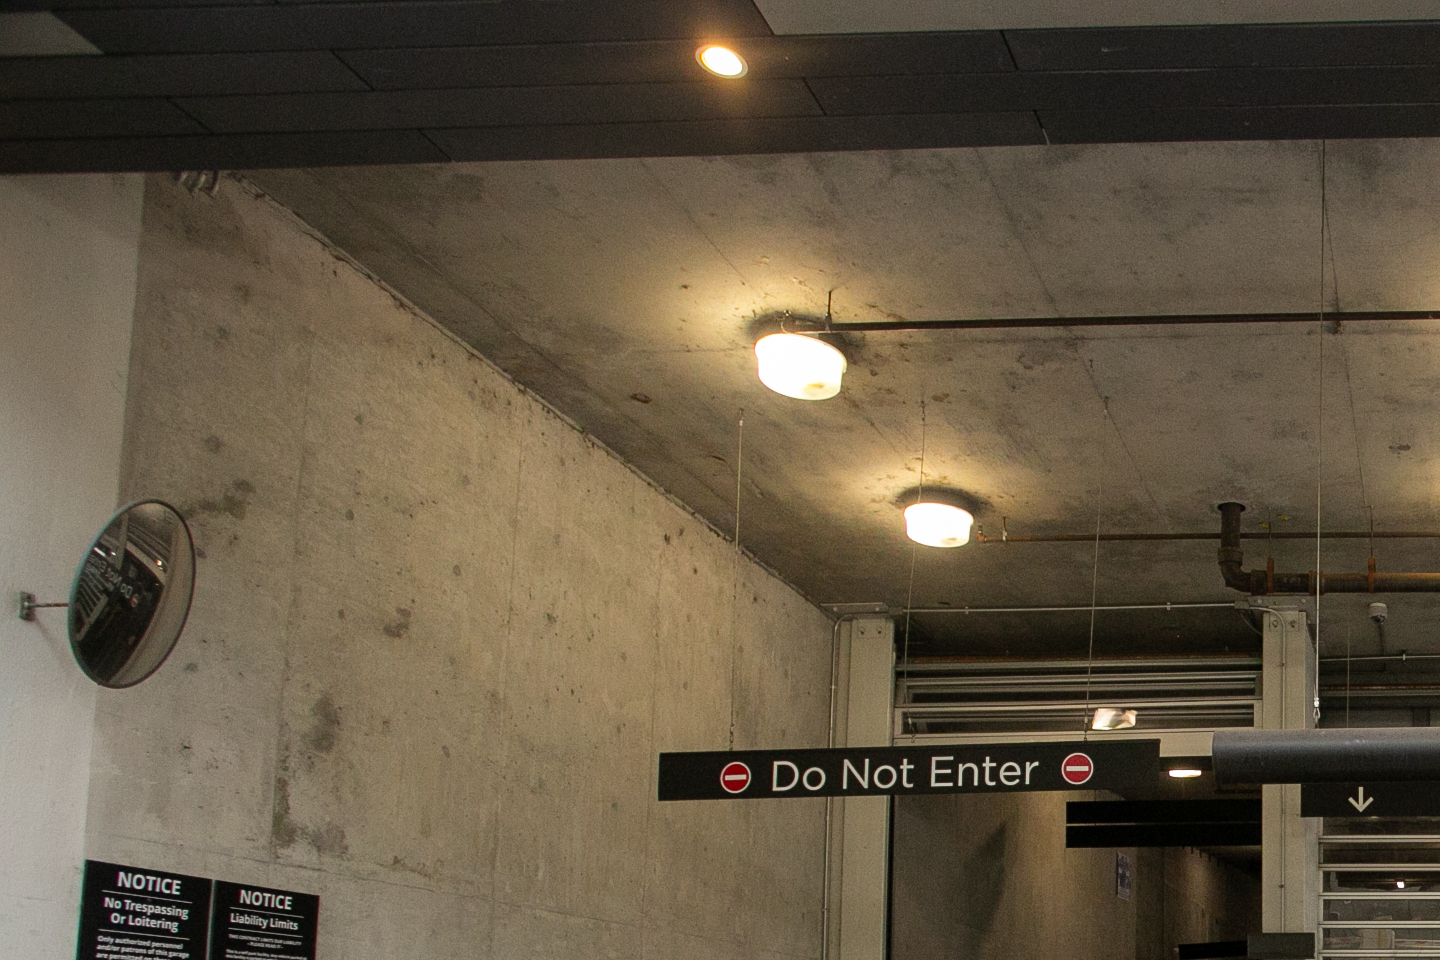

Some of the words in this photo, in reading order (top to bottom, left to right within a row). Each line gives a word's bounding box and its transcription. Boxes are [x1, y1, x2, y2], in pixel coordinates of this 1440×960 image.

[772, 761, 826, 791] Do
[843, 758, 914, 789] Not
[931, 756, 1039, 787] Enter
[117, 871, 182, 895] NOTICE
[103, 897, 122, 909] No
[124, 899, 189, 920] Trespassing
[239, 889, 293, 910] NOTICE
[110, 913, 126, 924] Or
[128, 915, 179, 933] Loitering
[229, 912, 268, 929] Liability
[269, 918, 299, 930] Limits
[97, 935, 114, 944] Only
[115, 937, 151, 946] authorized
[151, 941, 184, 949] personnel
[108, 953, 143, 960] permitted
[120, 946, 147, 954] patrons
[168, 951, 190, 959] garage
